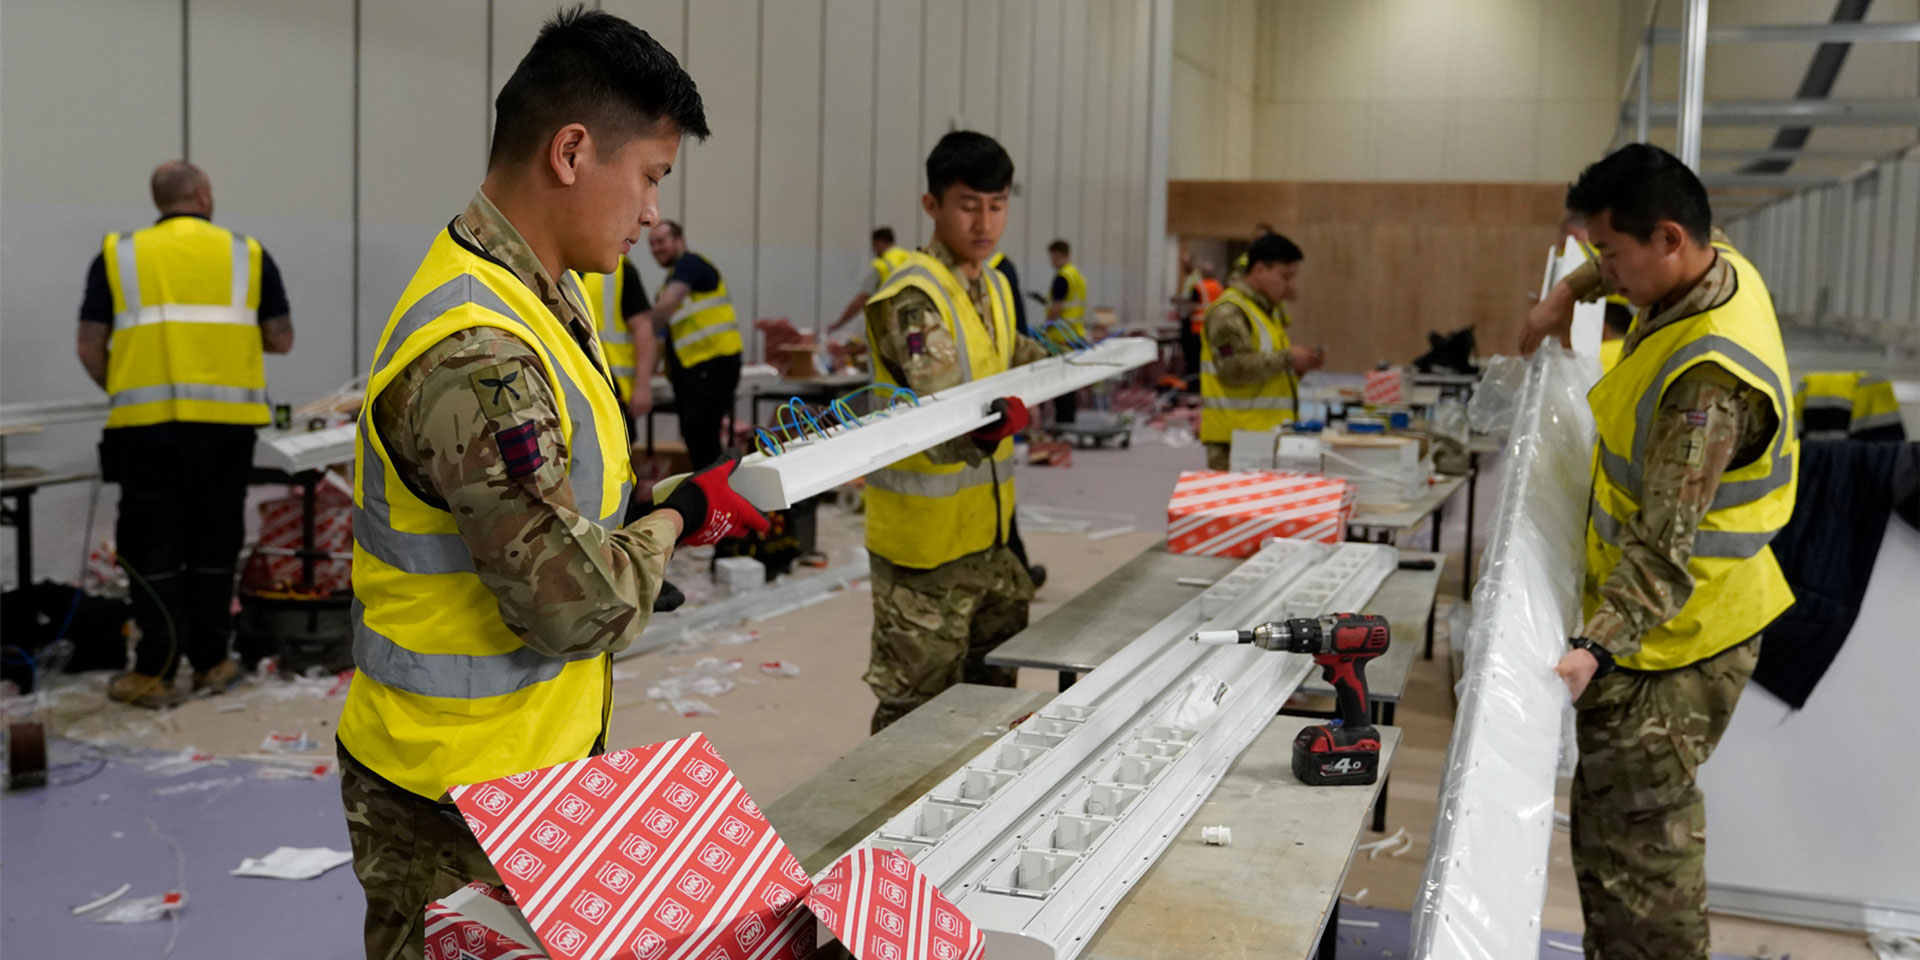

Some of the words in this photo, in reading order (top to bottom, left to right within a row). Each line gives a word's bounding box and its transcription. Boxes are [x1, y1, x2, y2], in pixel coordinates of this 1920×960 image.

[608, 750, 628, 766] MK
[1334, 758, 1361, 774] 4.0
[586, 773, 606, 791] MK
[693, 765, 712, 783] MK
[484, 792, 506, 810] MK
[673, 789, 692, 807] MK
[562, 799, 583, 817] MK
[652, 814, 672, 832] MK
[725, 821, 744, 839] MK
[538, 826, 559, 845] MK
[630, 841, 650, 859] MK
[704, 847, 724, 866] MK
[511, 854, 534, 874] MK
[607, 869, 628, 888] MK
[683, 875, 703, 895] MK
[582, 898, 604, 919] MK
[772, 890, 790, 909] MK
[661, 904, 682, 924] MK
[467, 928, 482, 942] MK
[557, 929, 580, 950] MK
[741, 922, 760, 944] MK
[639, 934, 658, 957] MK
